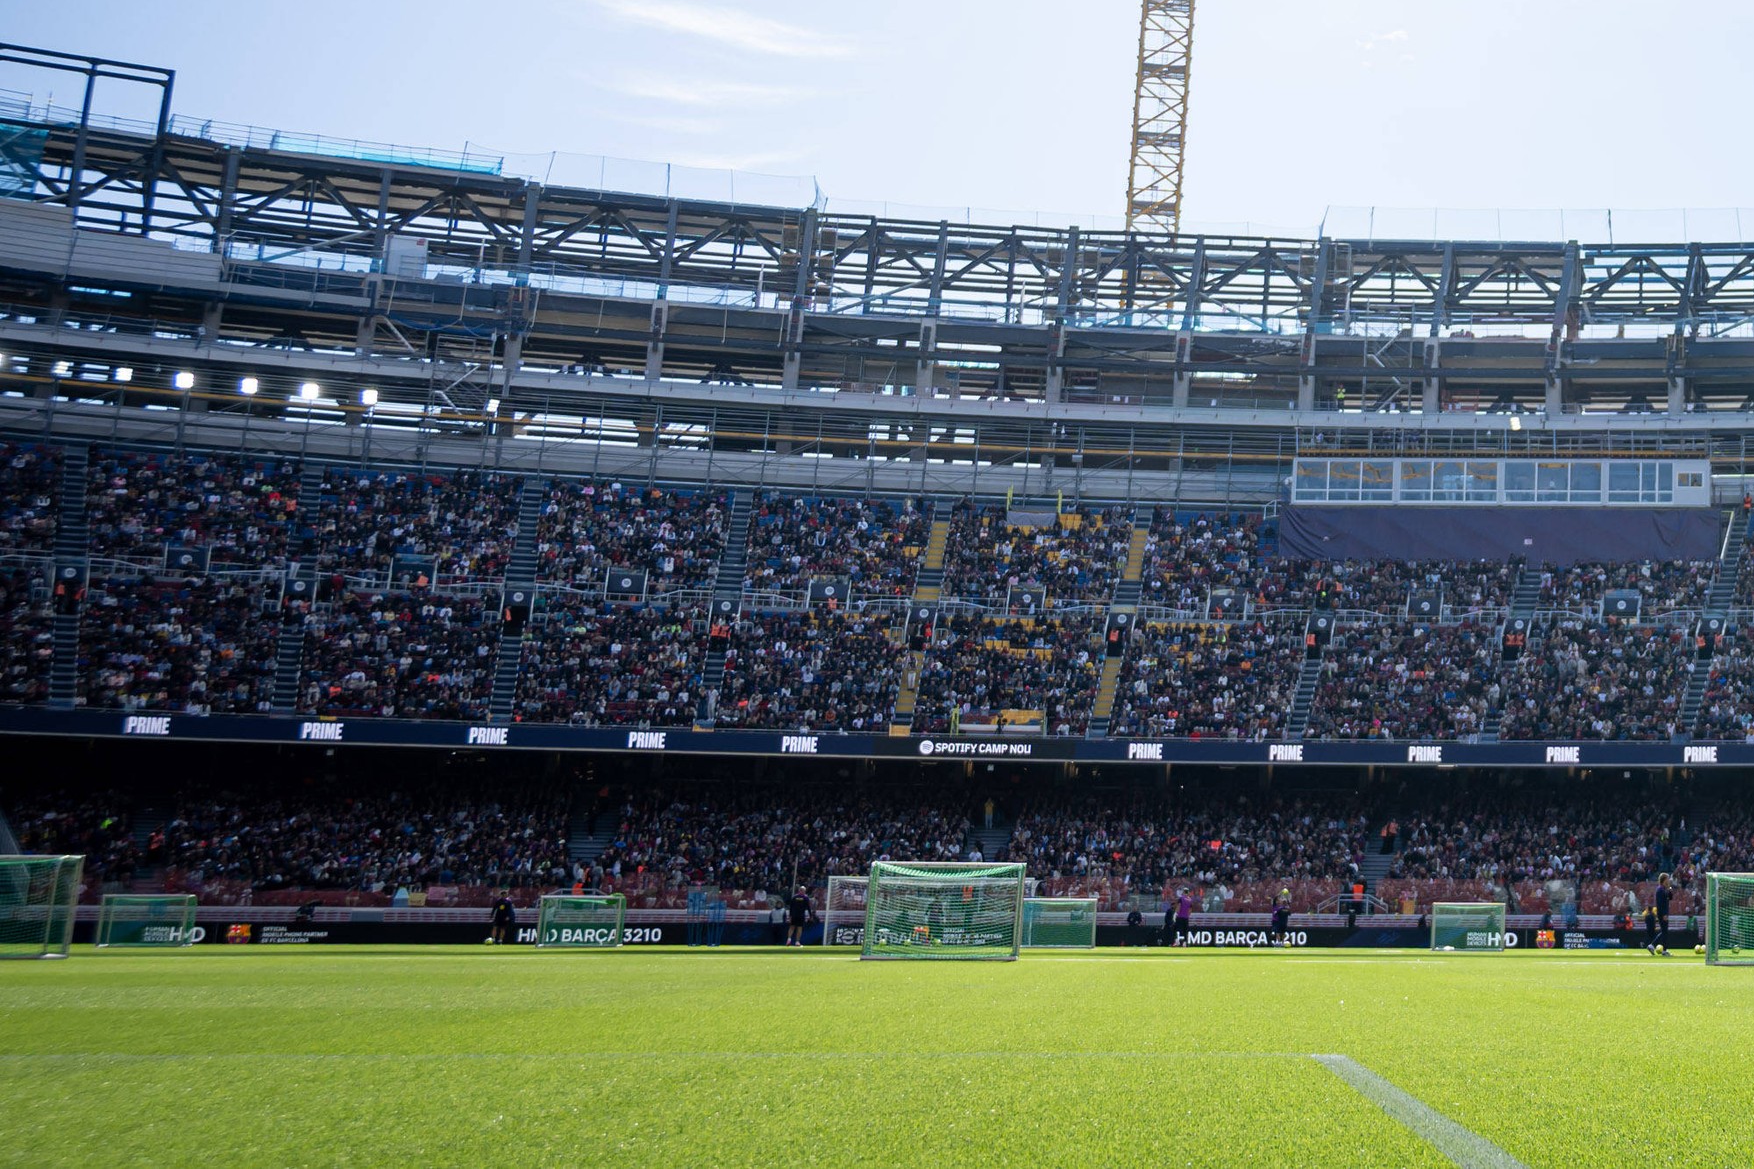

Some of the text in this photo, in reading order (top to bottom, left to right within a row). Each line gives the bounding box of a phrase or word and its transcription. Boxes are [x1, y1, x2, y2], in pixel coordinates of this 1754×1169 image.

[127, 716, 171, 735] PRIME
[302, 722, 344, 740] PRIME
[469, 727, 509, 745] PRIME
[628, 731, 667, 749] PRIME
[782, 736, 819, 753] PRIME
[935, 742, 1032, 755] SPOTIFY CAMP NOU
[1129, 743, 1163, 760] PRIME
[1269, 744, 1304, 761] PRIME
[1408, 746, 1442, 762] PRIME
[1546, 746, 1580, 763] PRIME
[1684, 746, 1718, 763] PRIME
[561, 928, 619, 945] BARÇA
[623, 928, 662, 942] 3210
[1215, 931, 1268, 948] BARÇA
